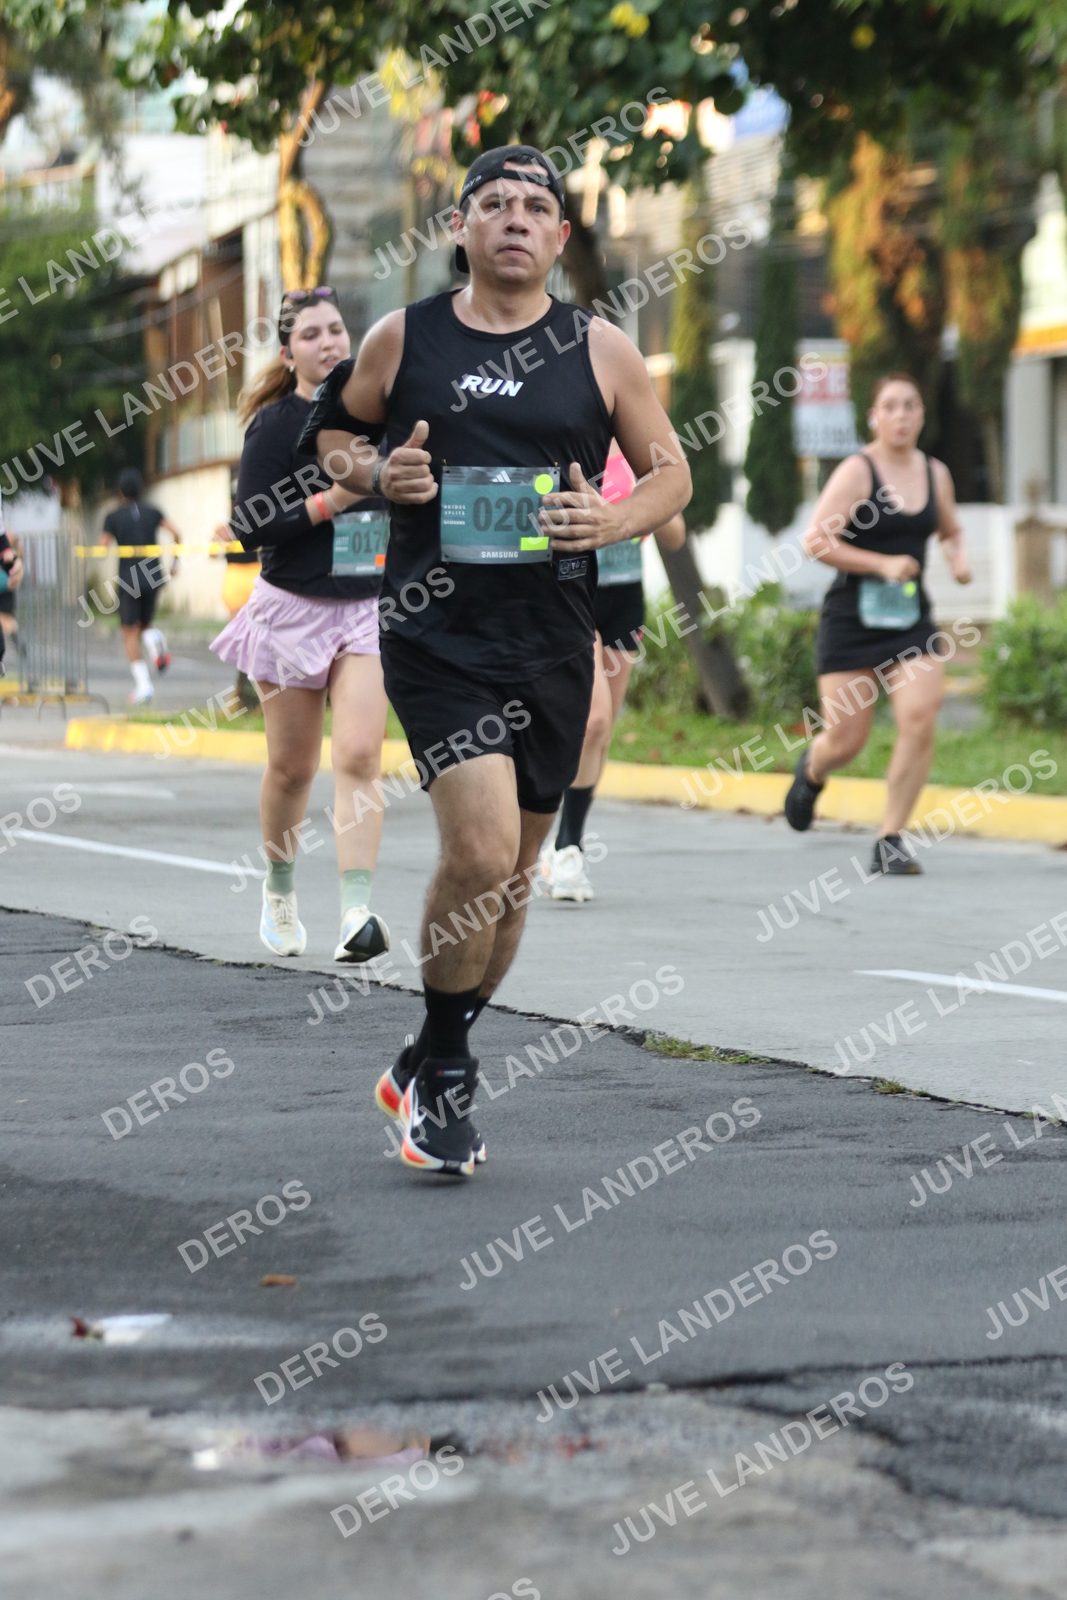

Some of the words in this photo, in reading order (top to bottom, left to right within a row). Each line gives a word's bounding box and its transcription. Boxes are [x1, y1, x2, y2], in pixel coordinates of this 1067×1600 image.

[460, 374, 524, 397] RUN
[472, 496, 542, 532] 020
[481, 551, 519, 559] SAMSUNG
